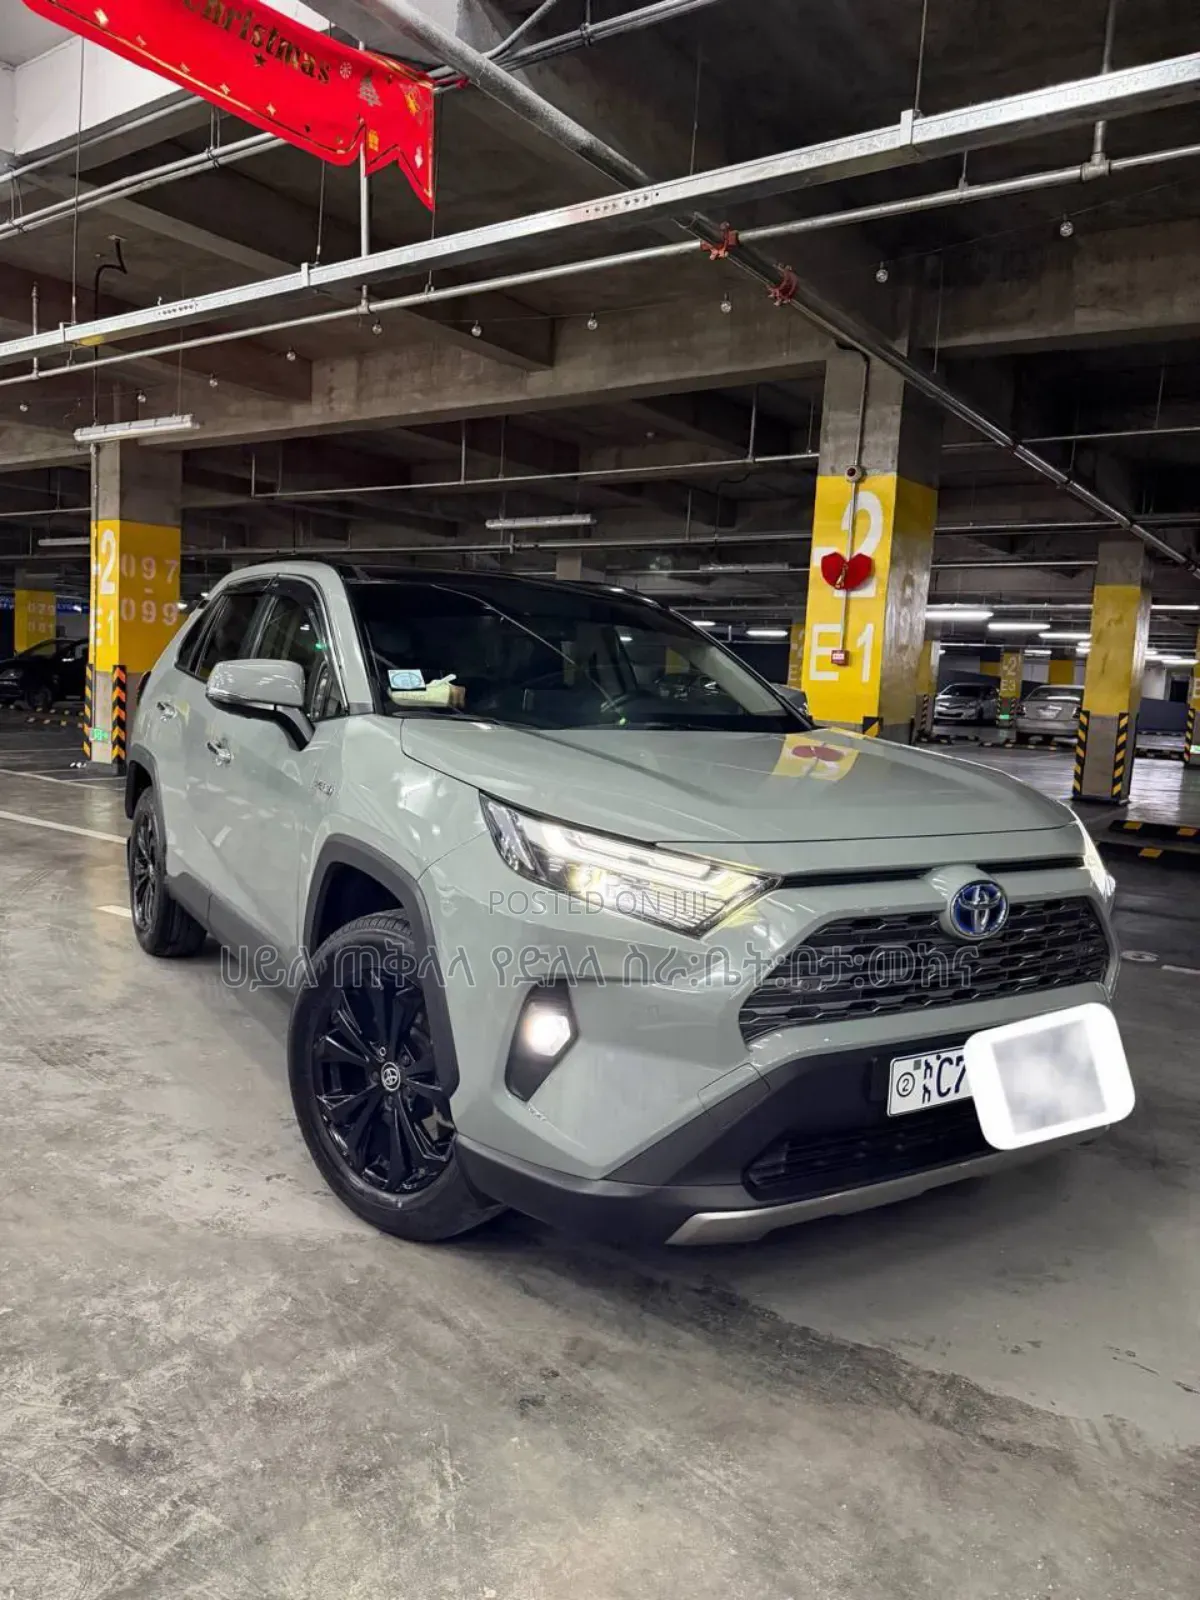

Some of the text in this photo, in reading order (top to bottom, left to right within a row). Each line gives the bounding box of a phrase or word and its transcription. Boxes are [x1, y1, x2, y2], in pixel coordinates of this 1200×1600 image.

[120, 553, 179, 584] 097
[89, 607, 116, 646] E1
[120, 597, 179, 626] 099
[809, 623, 874, 683] E1
